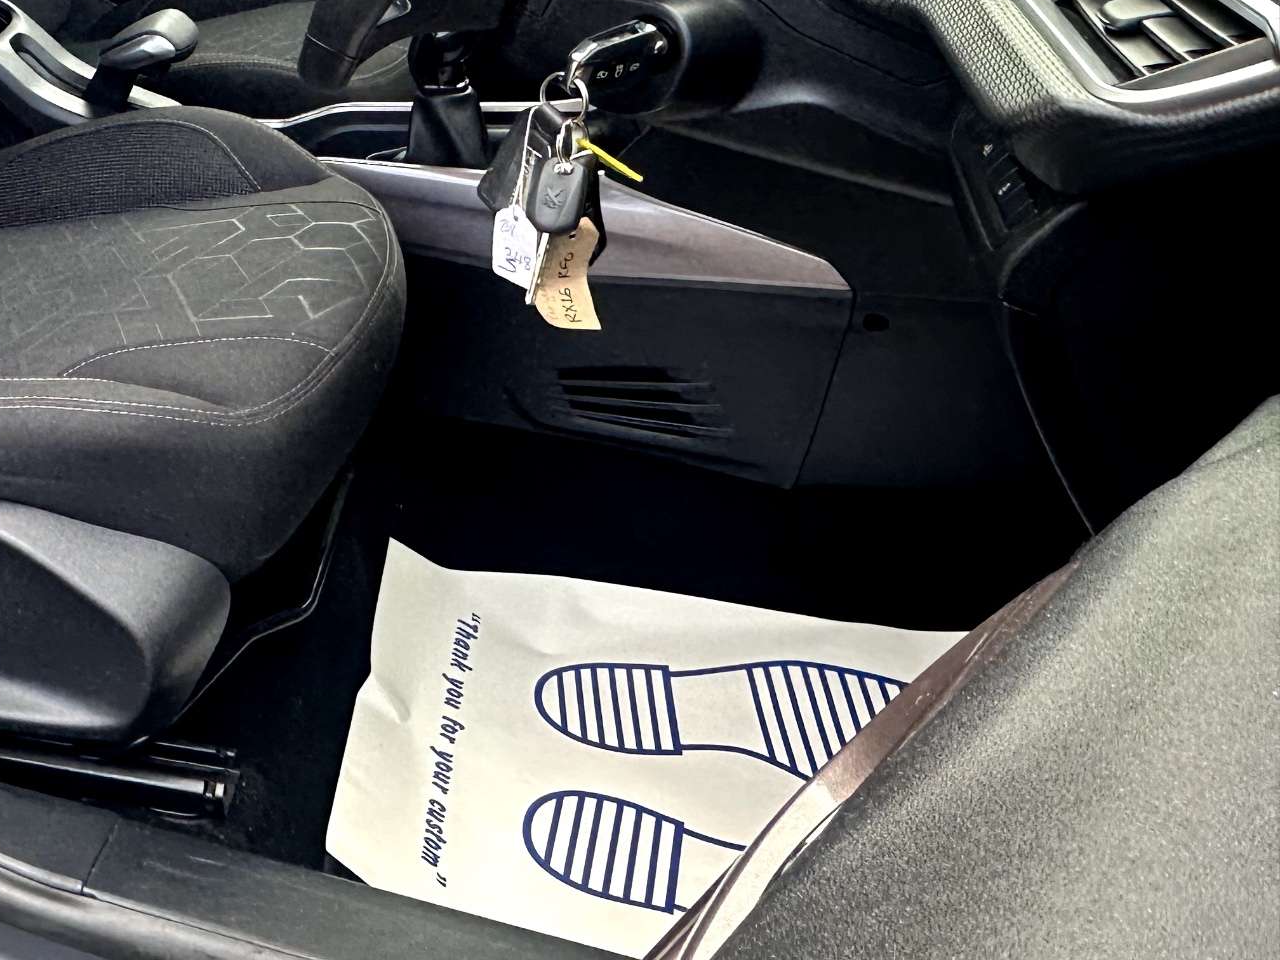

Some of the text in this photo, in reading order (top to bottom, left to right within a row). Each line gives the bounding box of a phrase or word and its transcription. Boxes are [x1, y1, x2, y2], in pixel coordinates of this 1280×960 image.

[442, 672, 465, 710] you
[439, 715, 465, 744] for
[429, 745, 454, 795] your
